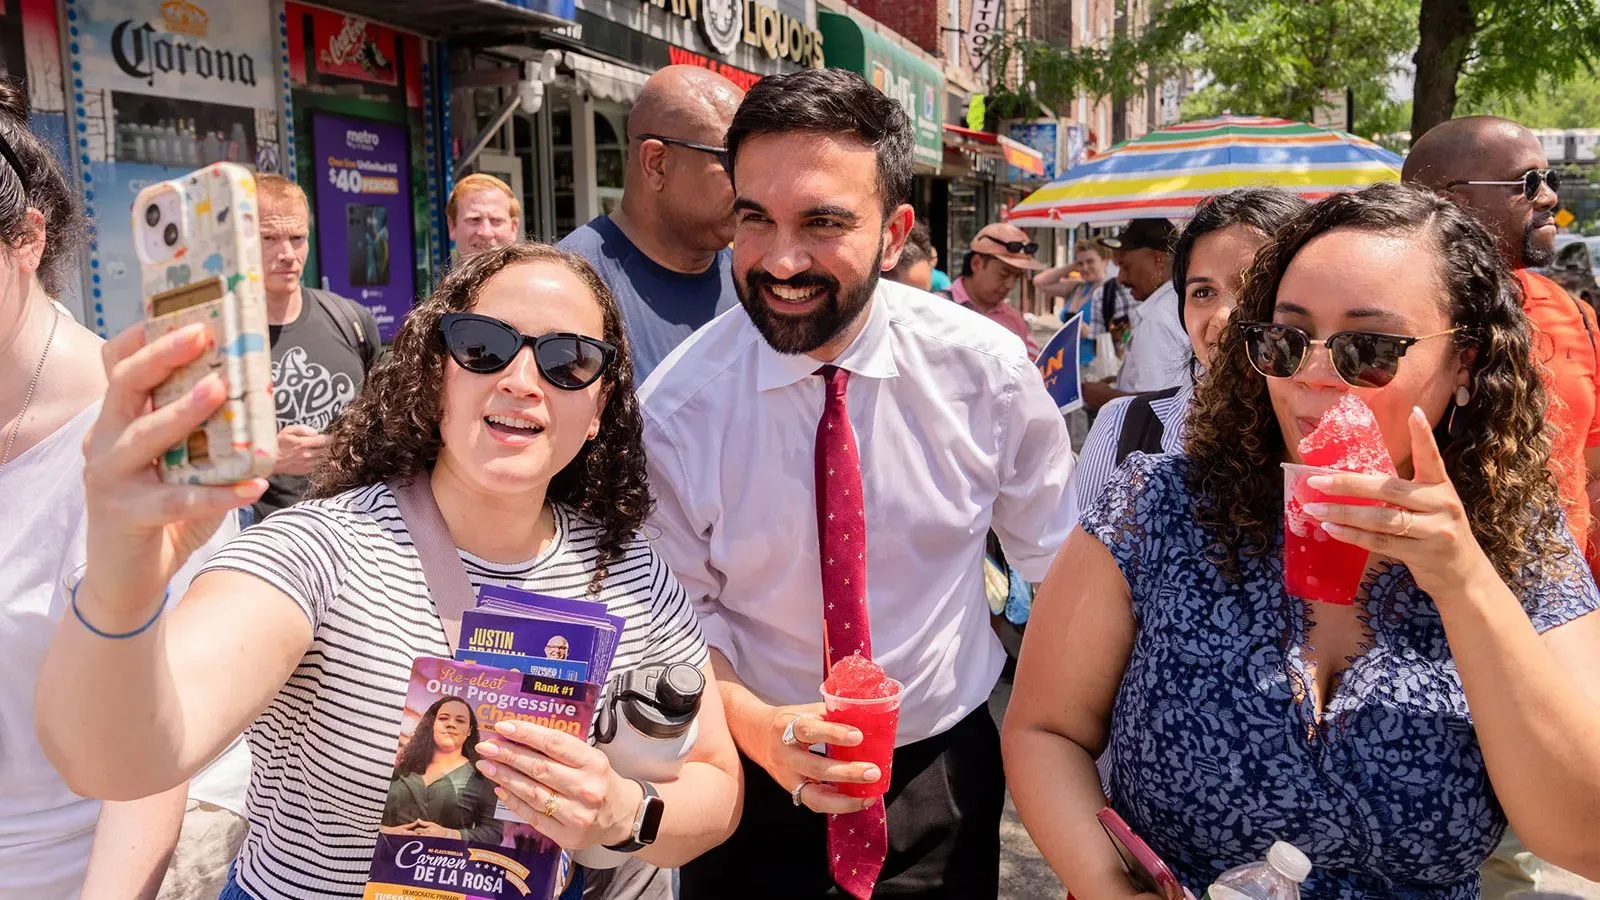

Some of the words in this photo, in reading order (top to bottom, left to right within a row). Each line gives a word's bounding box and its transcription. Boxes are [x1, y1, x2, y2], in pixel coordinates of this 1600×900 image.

[742, 0, 825, 70] LIQUORS
[110, 19, 257, 88] Corona
[346, 130, 379, 147] metro
[328, 167, 362, 194] $40
[469, 627, 515, 650] JUSTIN
[440, 666, 507, 691] Re-elect
[533, 681, 560, 695] Rank
[561, 686, 574, 697] #1
[426, 679, 463, 697] Our
[467, 685, 577, 717] Progressive
[394, 840, 467, 870] Carmen
[413, 865, 435, 883] DE
[438, 870, 458, 888] LA
[462, 873, 504, 894] ROSA
[402, 888, 436, 899] DEMOCRATIC
